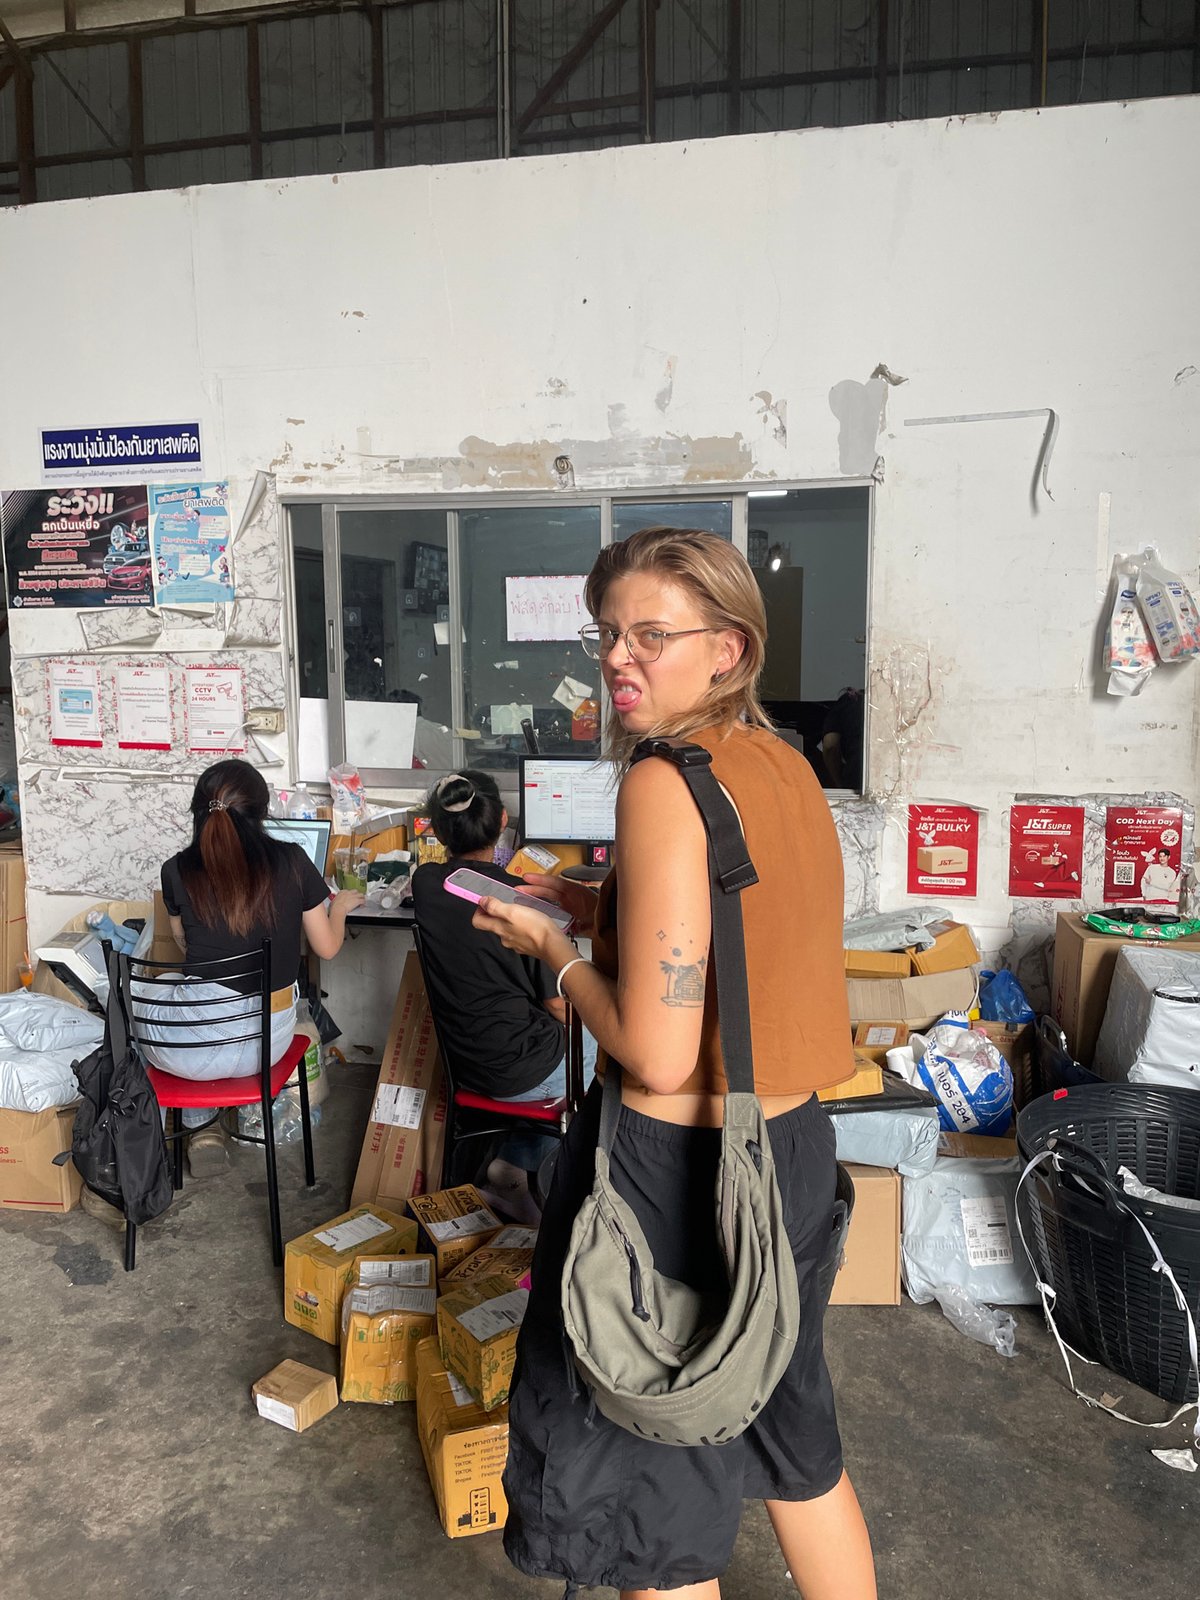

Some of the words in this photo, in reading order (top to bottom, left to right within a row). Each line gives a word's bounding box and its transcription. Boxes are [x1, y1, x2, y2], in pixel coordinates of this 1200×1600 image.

[47, 489, 114, 516] ระวัง!!
[184, 497, 225, 508] ยาเสพติด
[42, 516, 100, 532] ตกเป็นเหยื่อ
[915, 823, 935, 831] J&T
[936, 823, 971, 832] BULKY
[1022, 818, 1053, 829] J&T
